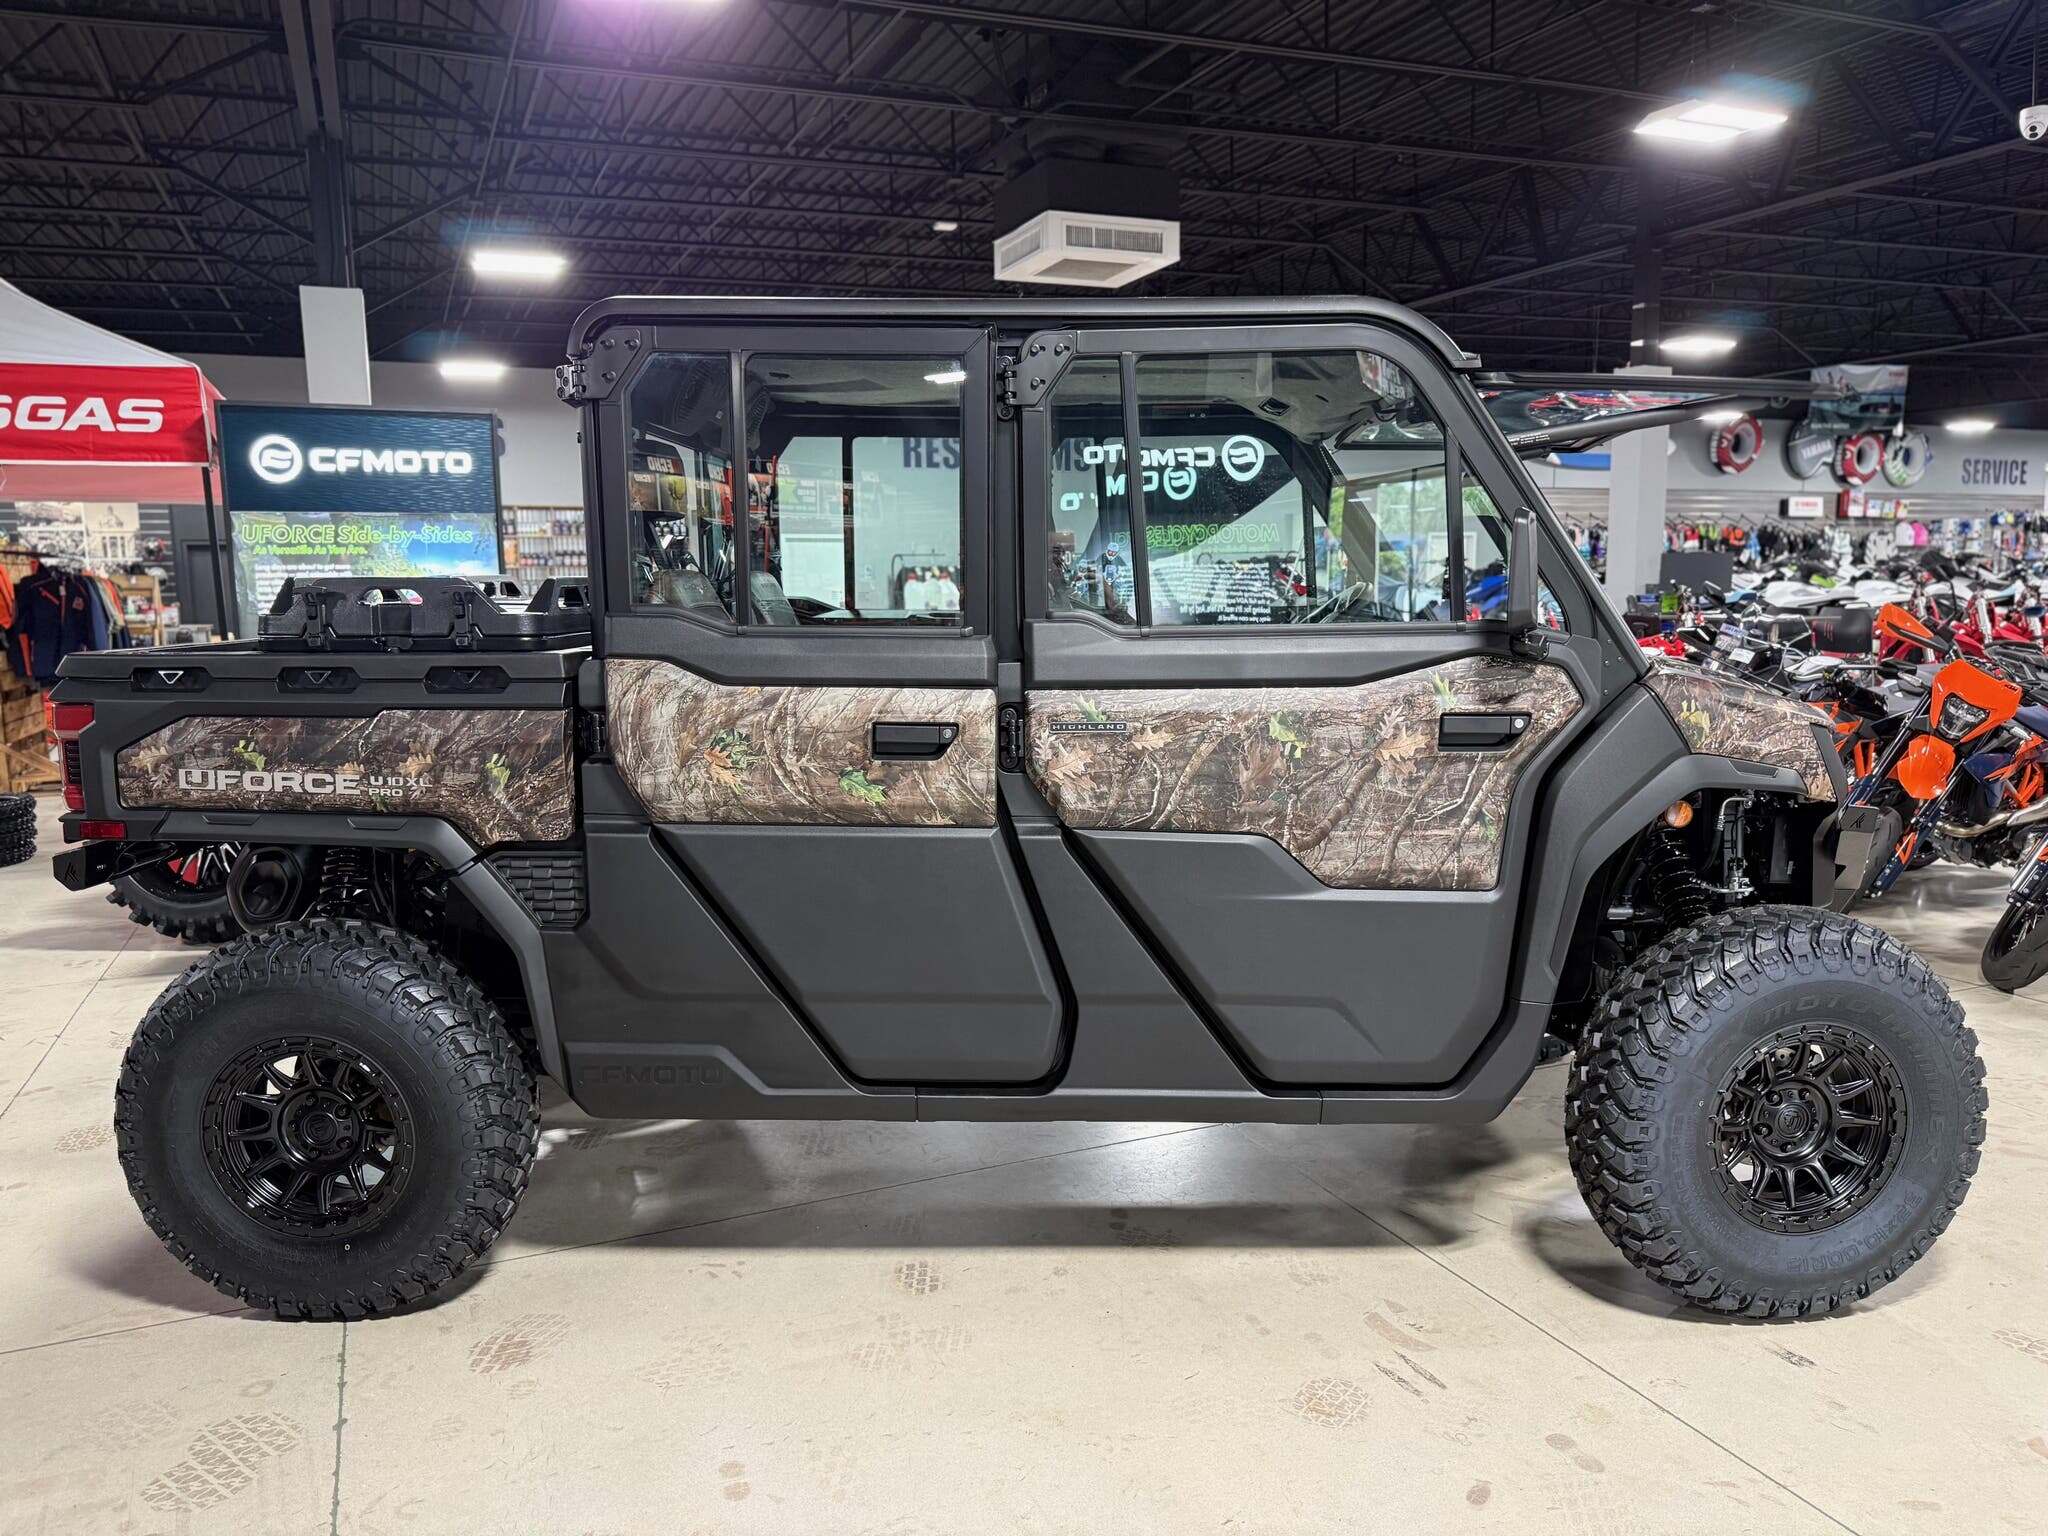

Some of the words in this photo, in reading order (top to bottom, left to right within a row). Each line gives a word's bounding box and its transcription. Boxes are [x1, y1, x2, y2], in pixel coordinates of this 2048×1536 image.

[0, 395, 165, 433] GAS
[308, 447, 474, 475] CFMOTO
[1961, 457, 2029, 486] SERVICE
[241, 524, 336, 544] UFORCE
[337, 524, 473, 546] Side-by-Sides
[178, 768, 361, 795] UFORCE
[369, 787, 403, 797] PRO
